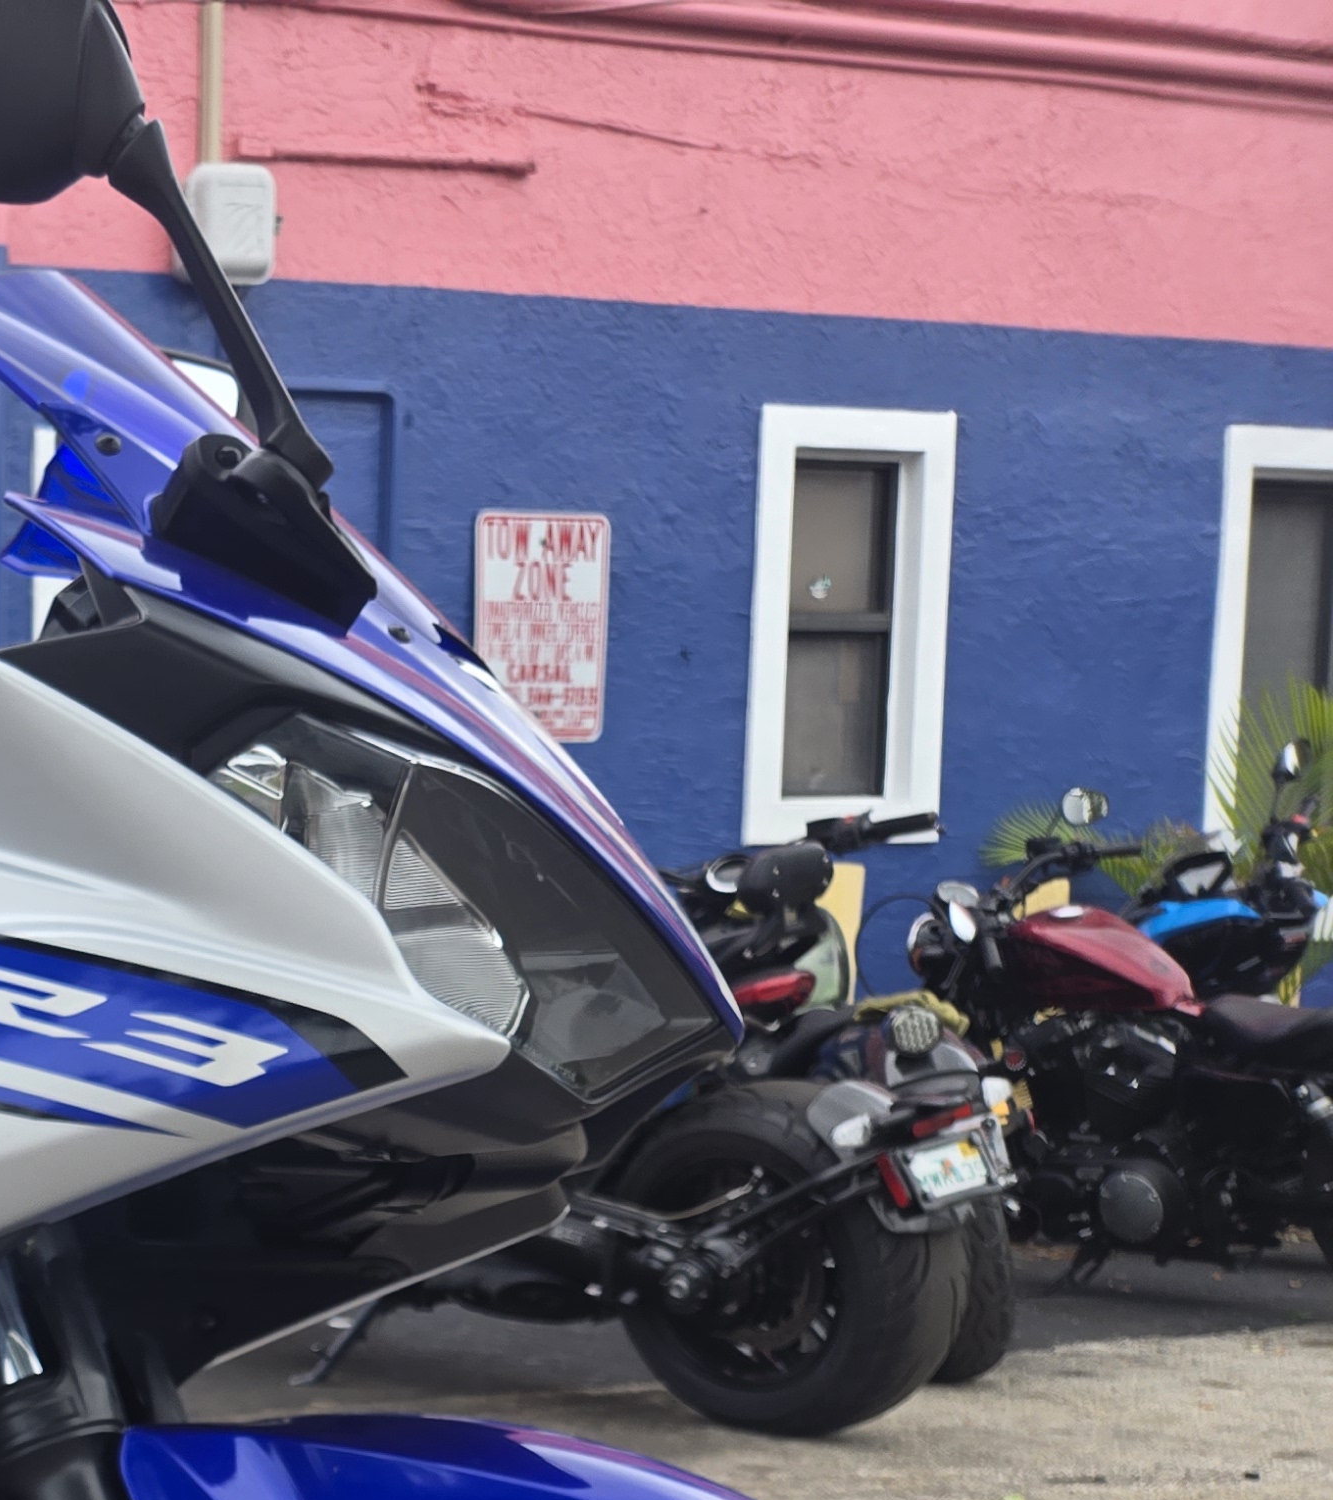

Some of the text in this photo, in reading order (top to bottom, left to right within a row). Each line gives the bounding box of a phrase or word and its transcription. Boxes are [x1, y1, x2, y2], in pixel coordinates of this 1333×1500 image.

[487, 517, 601, 563] TOW AWAY
[512, 561, 571, 601] ZONE
